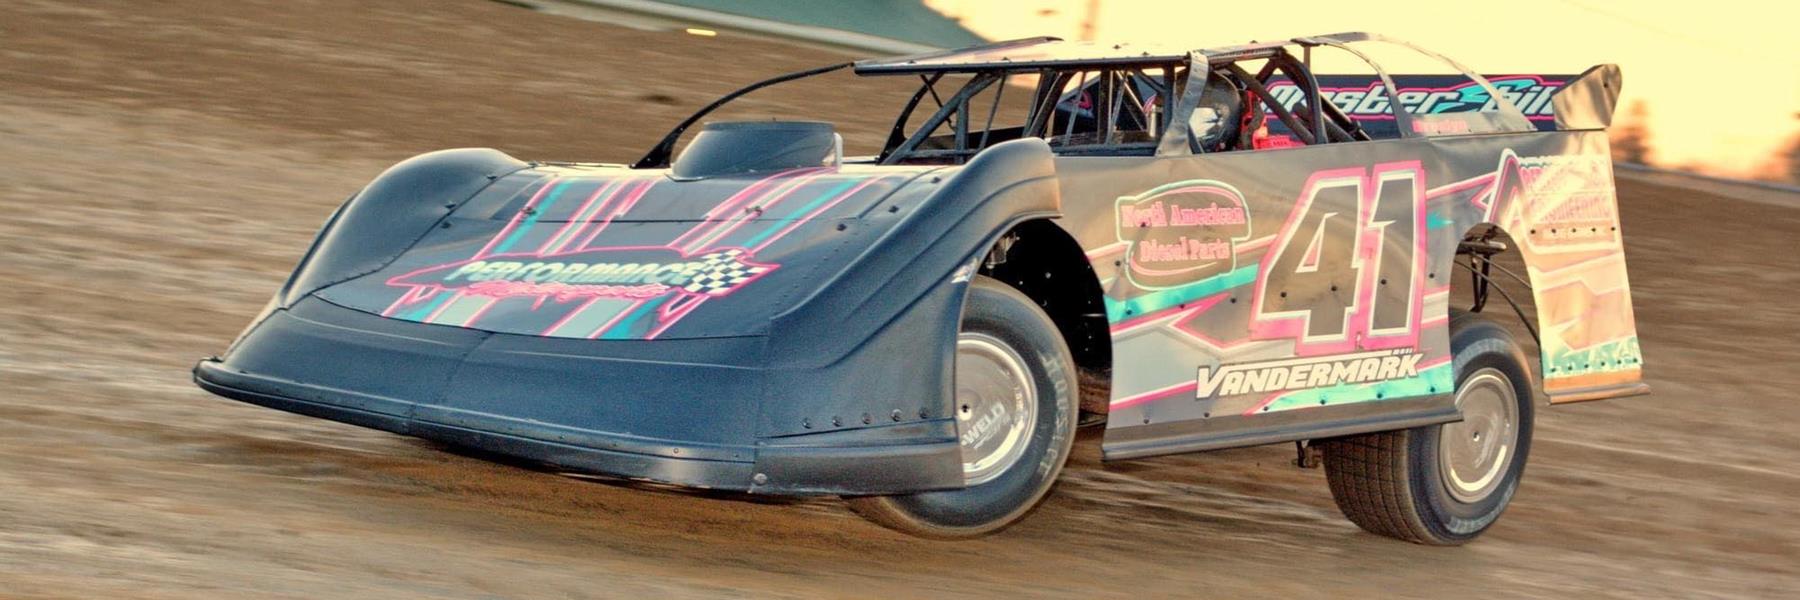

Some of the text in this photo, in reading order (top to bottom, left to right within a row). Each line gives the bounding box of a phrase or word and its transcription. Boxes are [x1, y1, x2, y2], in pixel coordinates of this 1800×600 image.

[1120, 201, 1246, 228] North American
[1140, 236, 1230, 262] Diesel Parts
[1254, 167, 1422, 346] 41
[445, 261, 704, 284] PERFORMANCE
[1196, 351, 1424, 399] VANDERMARK
